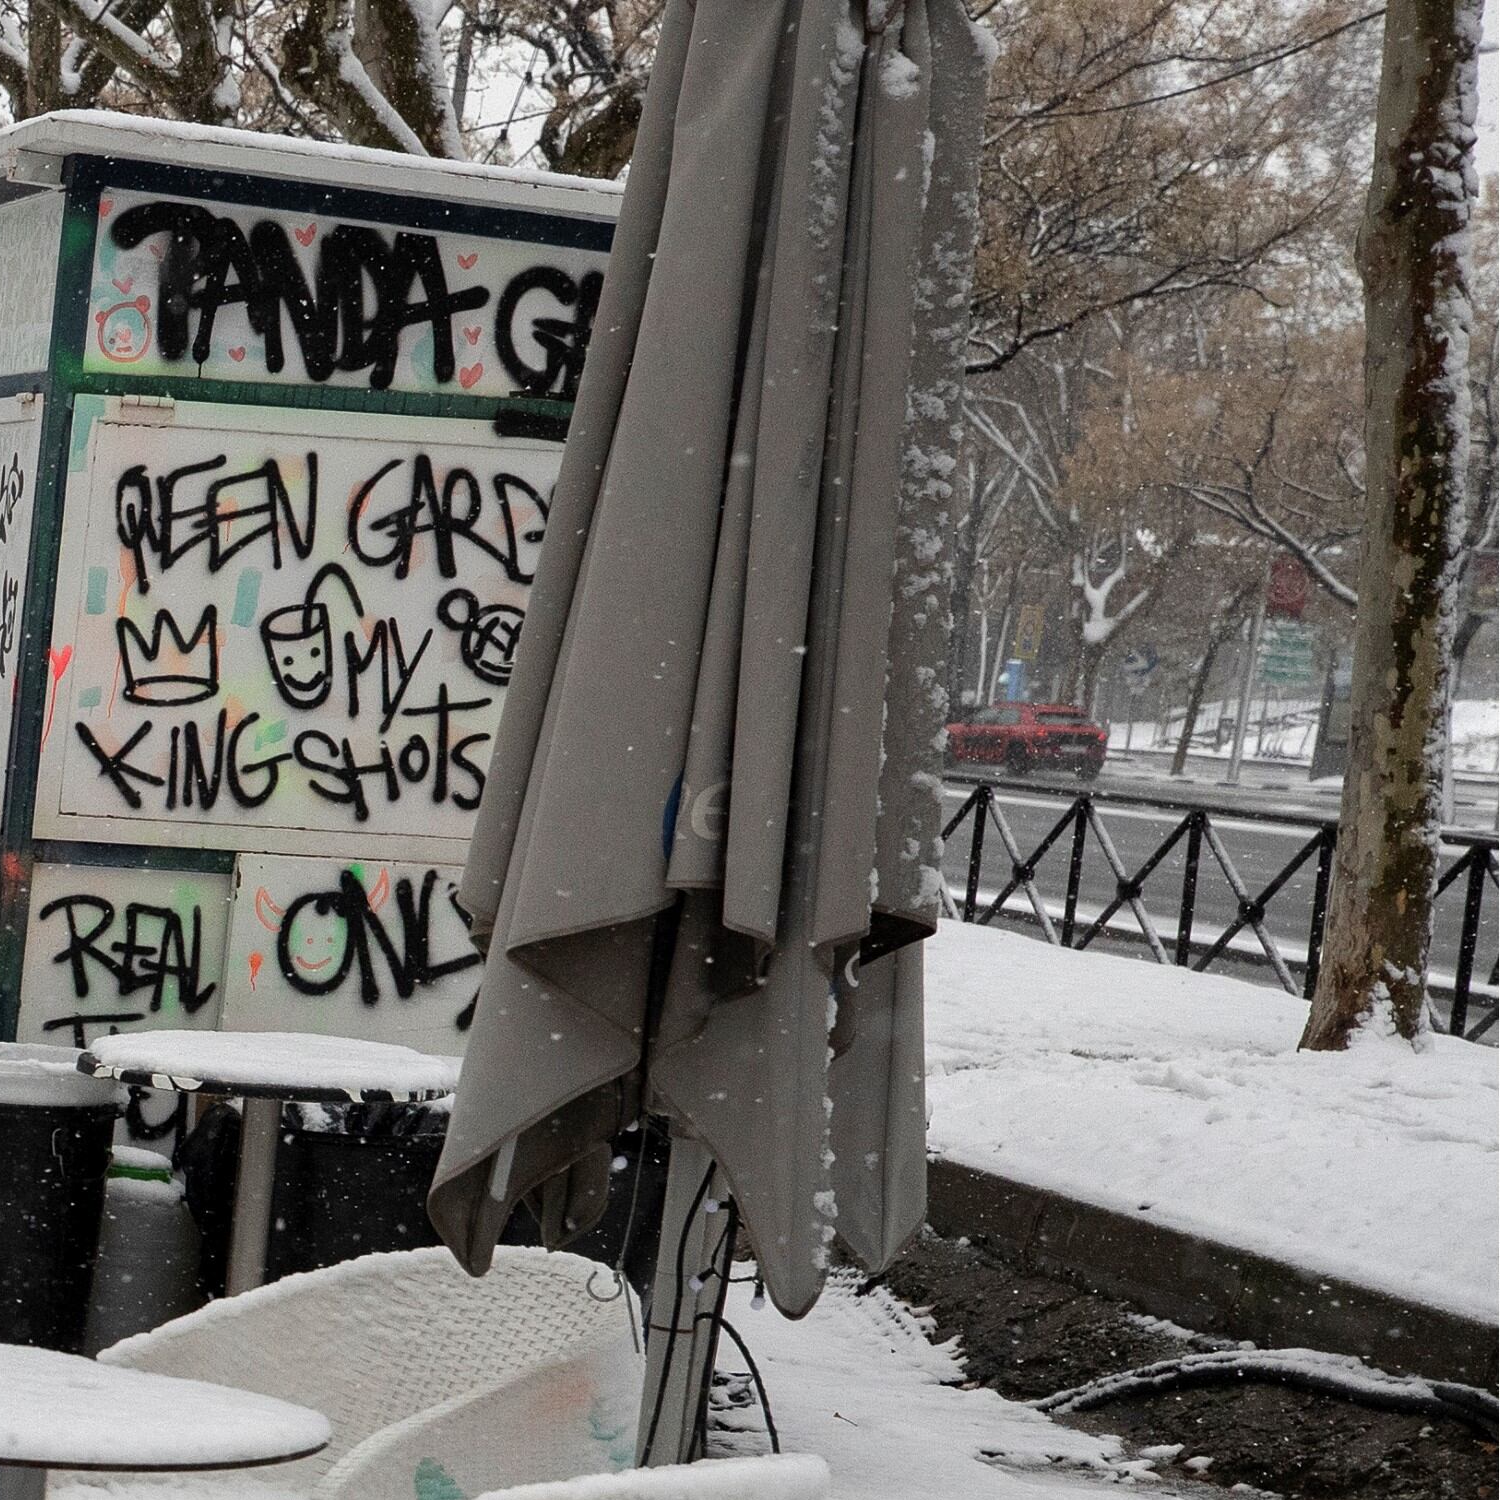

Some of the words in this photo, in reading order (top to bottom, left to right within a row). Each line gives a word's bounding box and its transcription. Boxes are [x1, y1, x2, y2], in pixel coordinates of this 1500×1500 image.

[111, 200, 491, 391] PANDA
[115, 452, 319, 595] QUEEN
[347, 453, 558, 586] GARD
[343, 615, 434, 734] MY
[38, 893, 217, 1014] REAL
